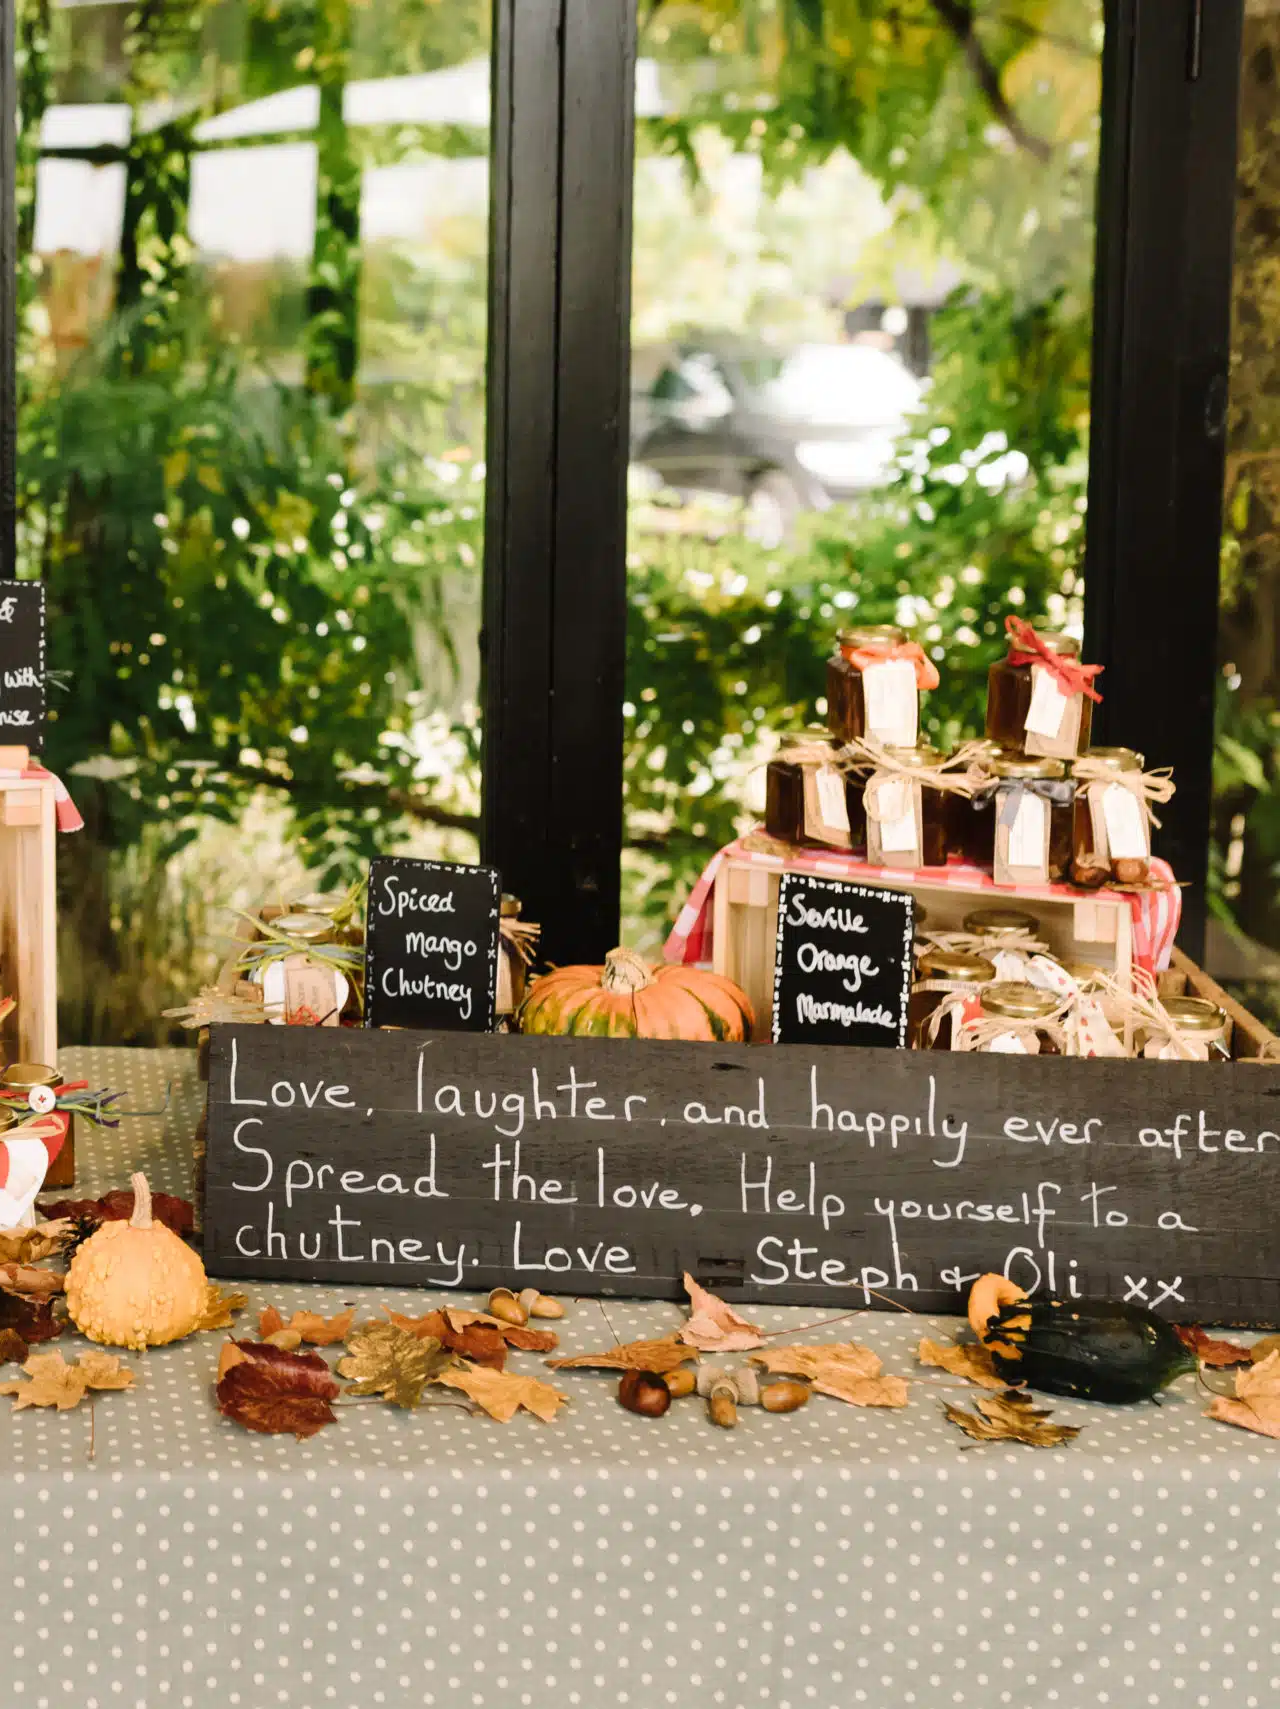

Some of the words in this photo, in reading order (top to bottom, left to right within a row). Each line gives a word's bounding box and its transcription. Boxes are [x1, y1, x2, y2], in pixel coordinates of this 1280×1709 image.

[378, 876, 456, 918] Spiced
[797, 942, 880, 992] Orange
[382, 968, 472, 1020] Chutney
[796, 993, 897, 1028] Marmalade
[683, 1077, 769, 1129] and
[811, 1065, 968, 1168] happily
[1003, 1116, 1103, 1145] ever
[1138, 1109, 1280, 1160] after
[231, 1118, 450, 1208] Spread
[482, 1140, 578, 1204] the
[741, 1152, 845, 1231] Help
[874, 1181, 1061, 1248] yourself
[1157, 1211, 1199, 1231] a
[513, 1221, 636, 1274] Love
[751, 1236, 918, 1304] Steph
[1004, 1247, 1082, 1298] Oli
